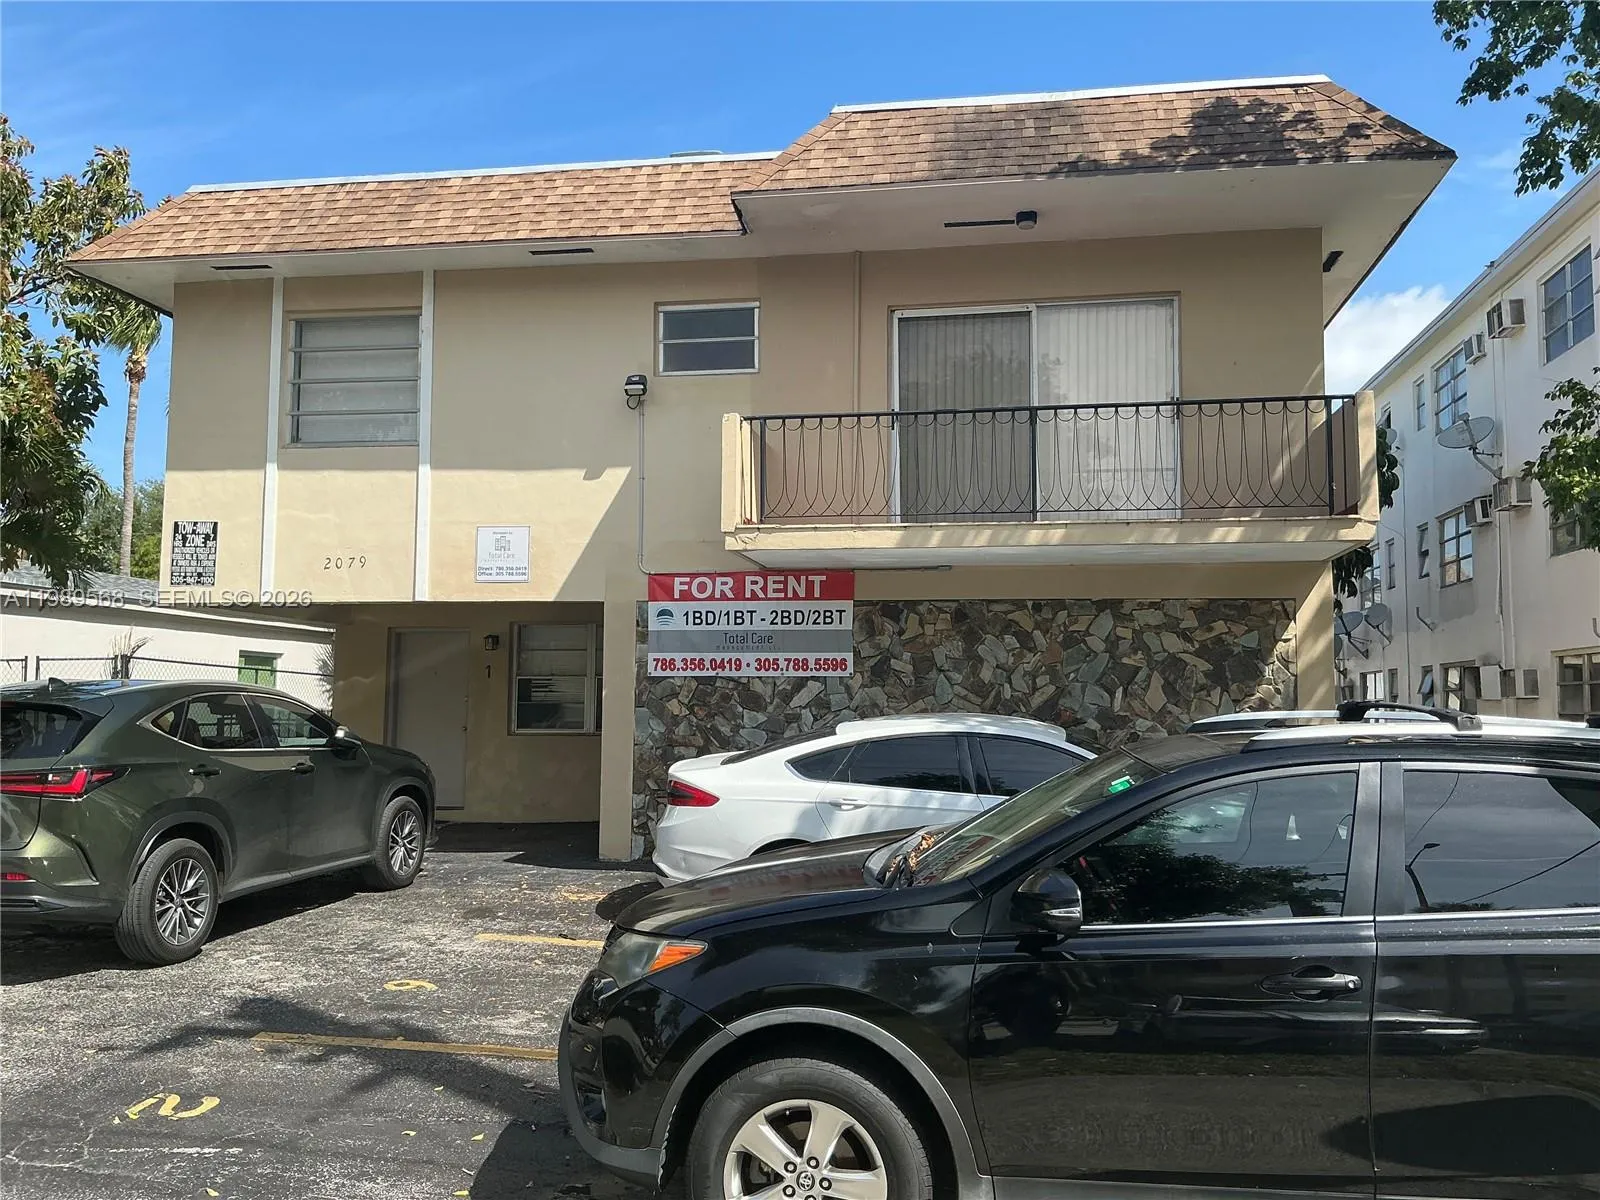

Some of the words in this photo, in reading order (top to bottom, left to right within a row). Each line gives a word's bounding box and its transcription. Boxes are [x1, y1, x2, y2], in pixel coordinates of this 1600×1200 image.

[177, 522, 215, 534] TOW-AWAY
[175, 533, 183, 541] 24
[185, 534, 206, 547] ZONE
[209, 533, 215, 541] 7
[323, 555, 367, 570] 2079
[673, 576, 734, 599] FOR
[744, 575, 827, 598] RENT
[682, 610, 757, 627] 1BD/1BT
[769, 609, 847, 626] 2BD/2BT
[723, 632, 749, 644] Total
[751, 632, 774, 644] Care
[485, 664, 491, 679] 1
[652, 657, 743, 672] 786.356.0419
[754, 657, 849, 672] 305.788.5596
